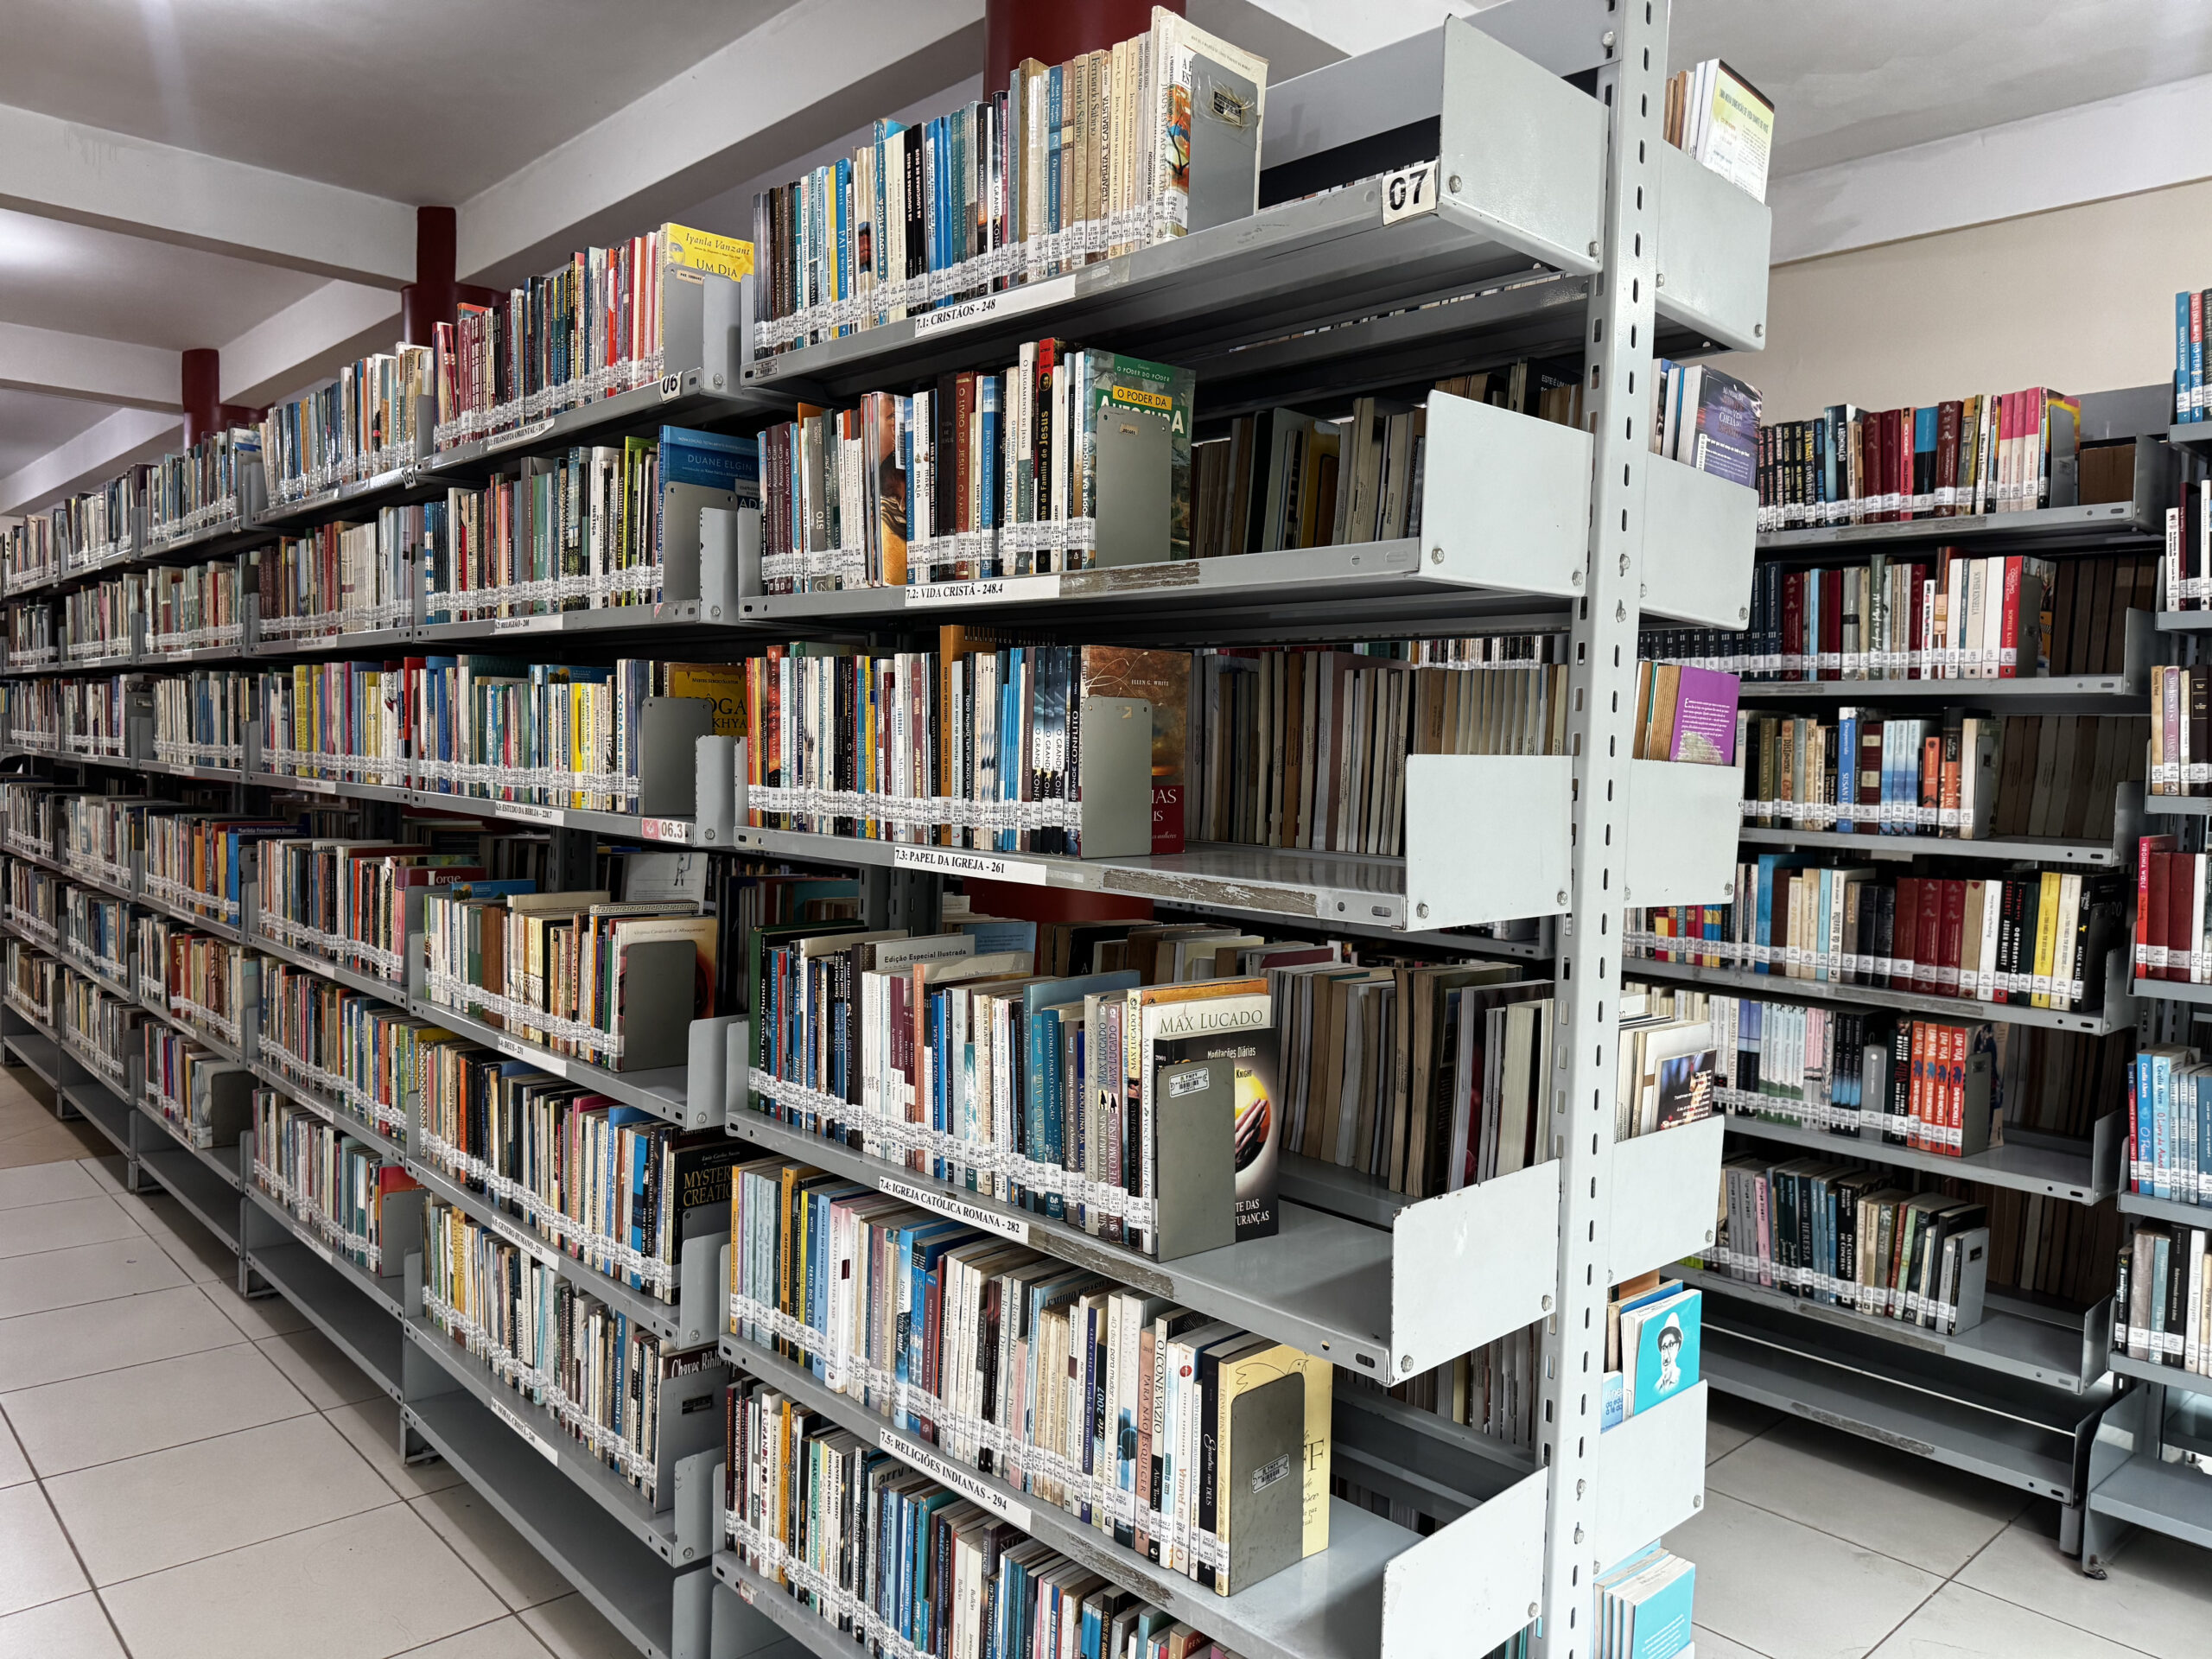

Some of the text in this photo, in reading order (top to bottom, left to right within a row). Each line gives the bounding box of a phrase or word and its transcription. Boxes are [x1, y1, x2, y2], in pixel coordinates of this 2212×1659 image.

[1076, 65, 1085, 143] Fernando Sabino
[1091, 57, 1100, 136] Fernando Sabino
[1389, 168, 1428, 211] 07
[685, 232, 750, 256] Iyanla Vanzant
[696, 259, 738, 277] UM DIA
[916, 299, 996, 330] 7.1: CRISTÃOS 248
[662, 372, 678, 394] 06
[1152, 373, 1170, 382] PODER
[1117, 389, 1167, 407] O PODER DA
[959, 432, 964, 444] DE
[1837, 427, 1846, 461] ABOMINAÇÃO
[687, 454, 752, 471] DUANE ELGIN
[906, 582, 1003, 599] 7.2: VIDA CRISTÃ 248.4
[502, 804, 518, 814] ESTUDO
[525, 807, 539, 817] BÍBLIA
[661, 821, 683, 838] 06.3
[895, 850, 1005, 873] 7.3: PAPEL DA IGREJA 261
[2002, 920, 2010, 941] ADRIAN
[884, 948, 966, 964] Edição Especial Ilustrada
[1160, 1009, 1263, 1034] MAX LUCADO
[1098, 1023, 1107, 1084] MAX LUCADO
[1238, 1046, 1256, 1058] Diárias
[1914, 1028, 1923, 1055] UM DIA
[1927, 1029, 1937, 1056] UM DIA
[1939, 1032, 1948, 1059] UM DIA
[1953, 1033, 1963, 1061] UM DIA
[1109, 1025, 1117, 1087] MAX LUCADO
[1098, 1138, 1107, 1163] COMO
[683, 1166, 732, 1189] MYSTER
[880, 1179, 1020, 1233] 7.4: IGREJA CATÓLICA ROMANA 282
[1246, 1198, 1260, 1211] DAS
[1236, 1210, 1269, 1226] URANÇAS
[1802, 1222, 1810, 1261] HERESIA
[1112, 1316, 1117, 1327] 40
[1158, 1340, 1165, 1349] O
[1154, 1394, 1163, 1433] VAZIO
[881, 1431, 1007, 1510] 7.5: RELIGIÕES INDIANAS 294
[1140, 1432, 1149, 1492] ESQUECER
